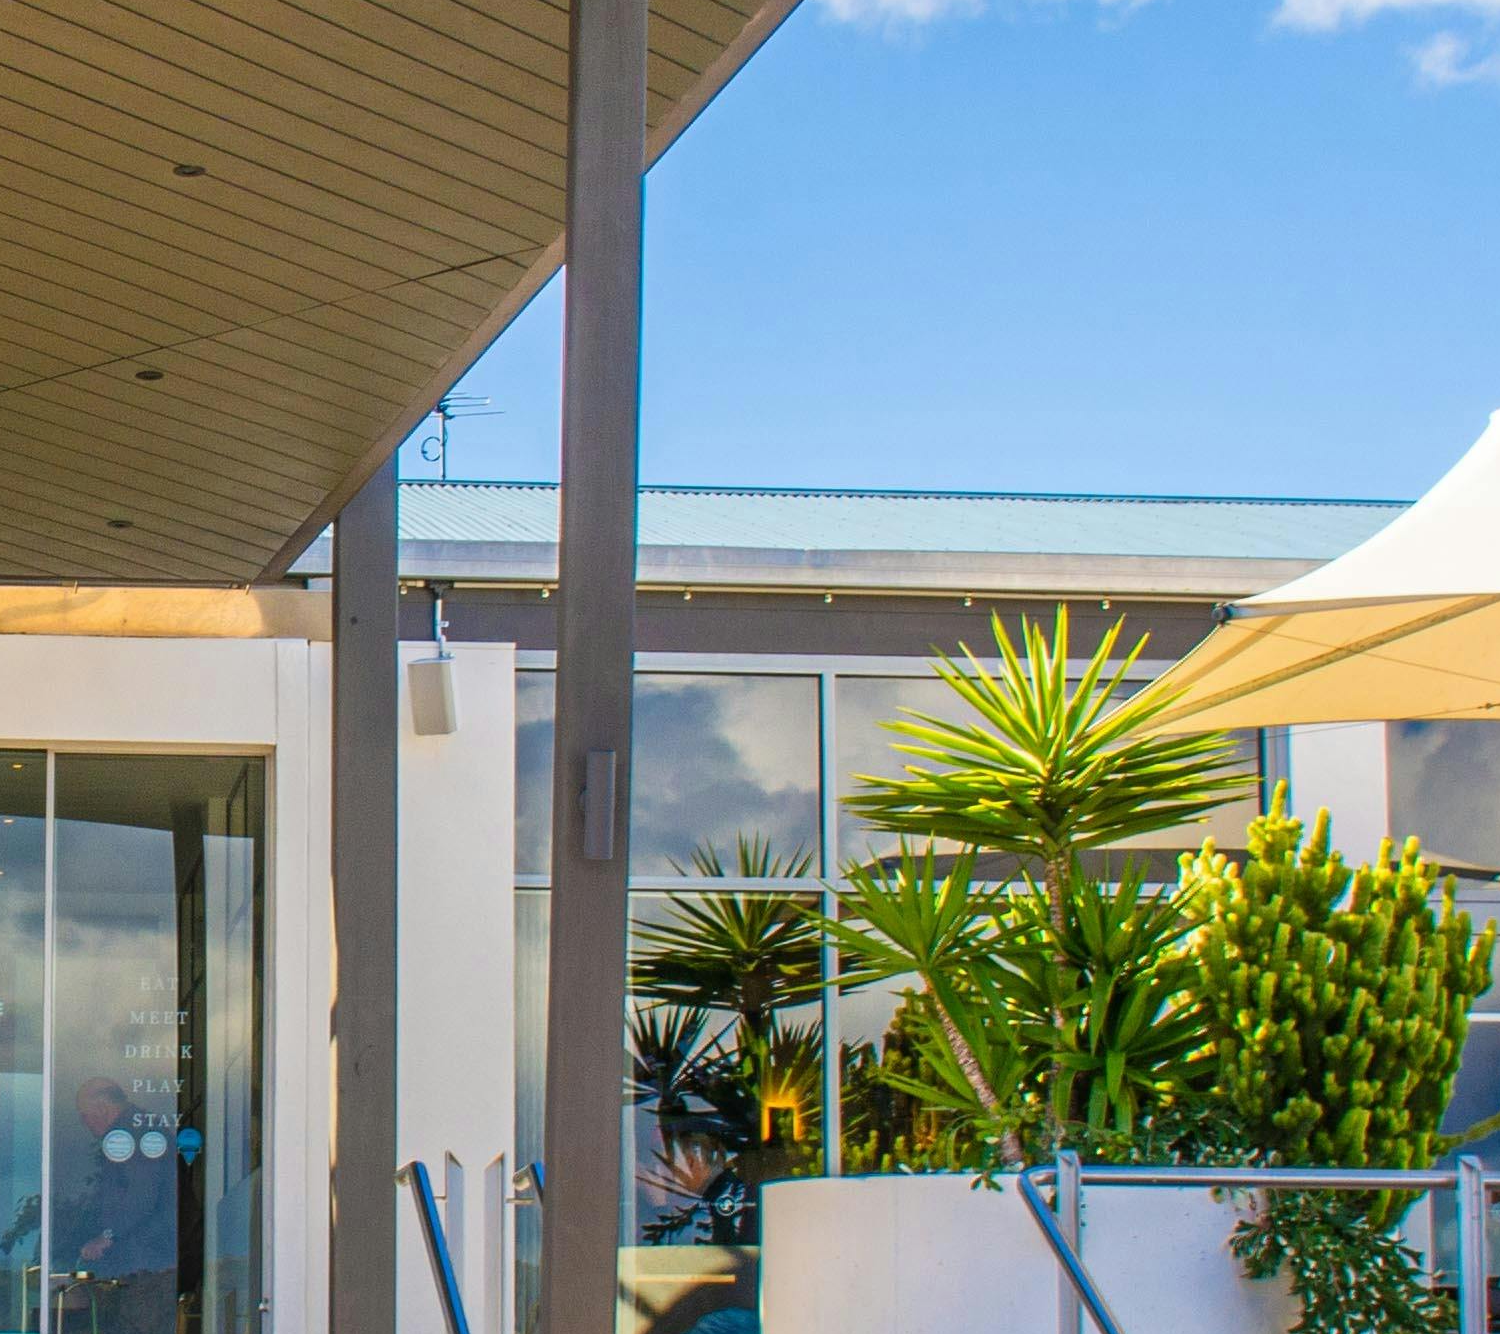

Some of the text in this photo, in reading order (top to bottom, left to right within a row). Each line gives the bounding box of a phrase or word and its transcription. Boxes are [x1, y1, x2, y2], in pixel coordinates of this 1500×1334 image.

[140, 977, 179, 990] EAT
[129, 1010, 189, 1025] MEET
[124, 1044, 193, 1059] DRINK
[132, 1079, 185, 1093] PLAY
[132, 1113, 184, 1127] STAY
